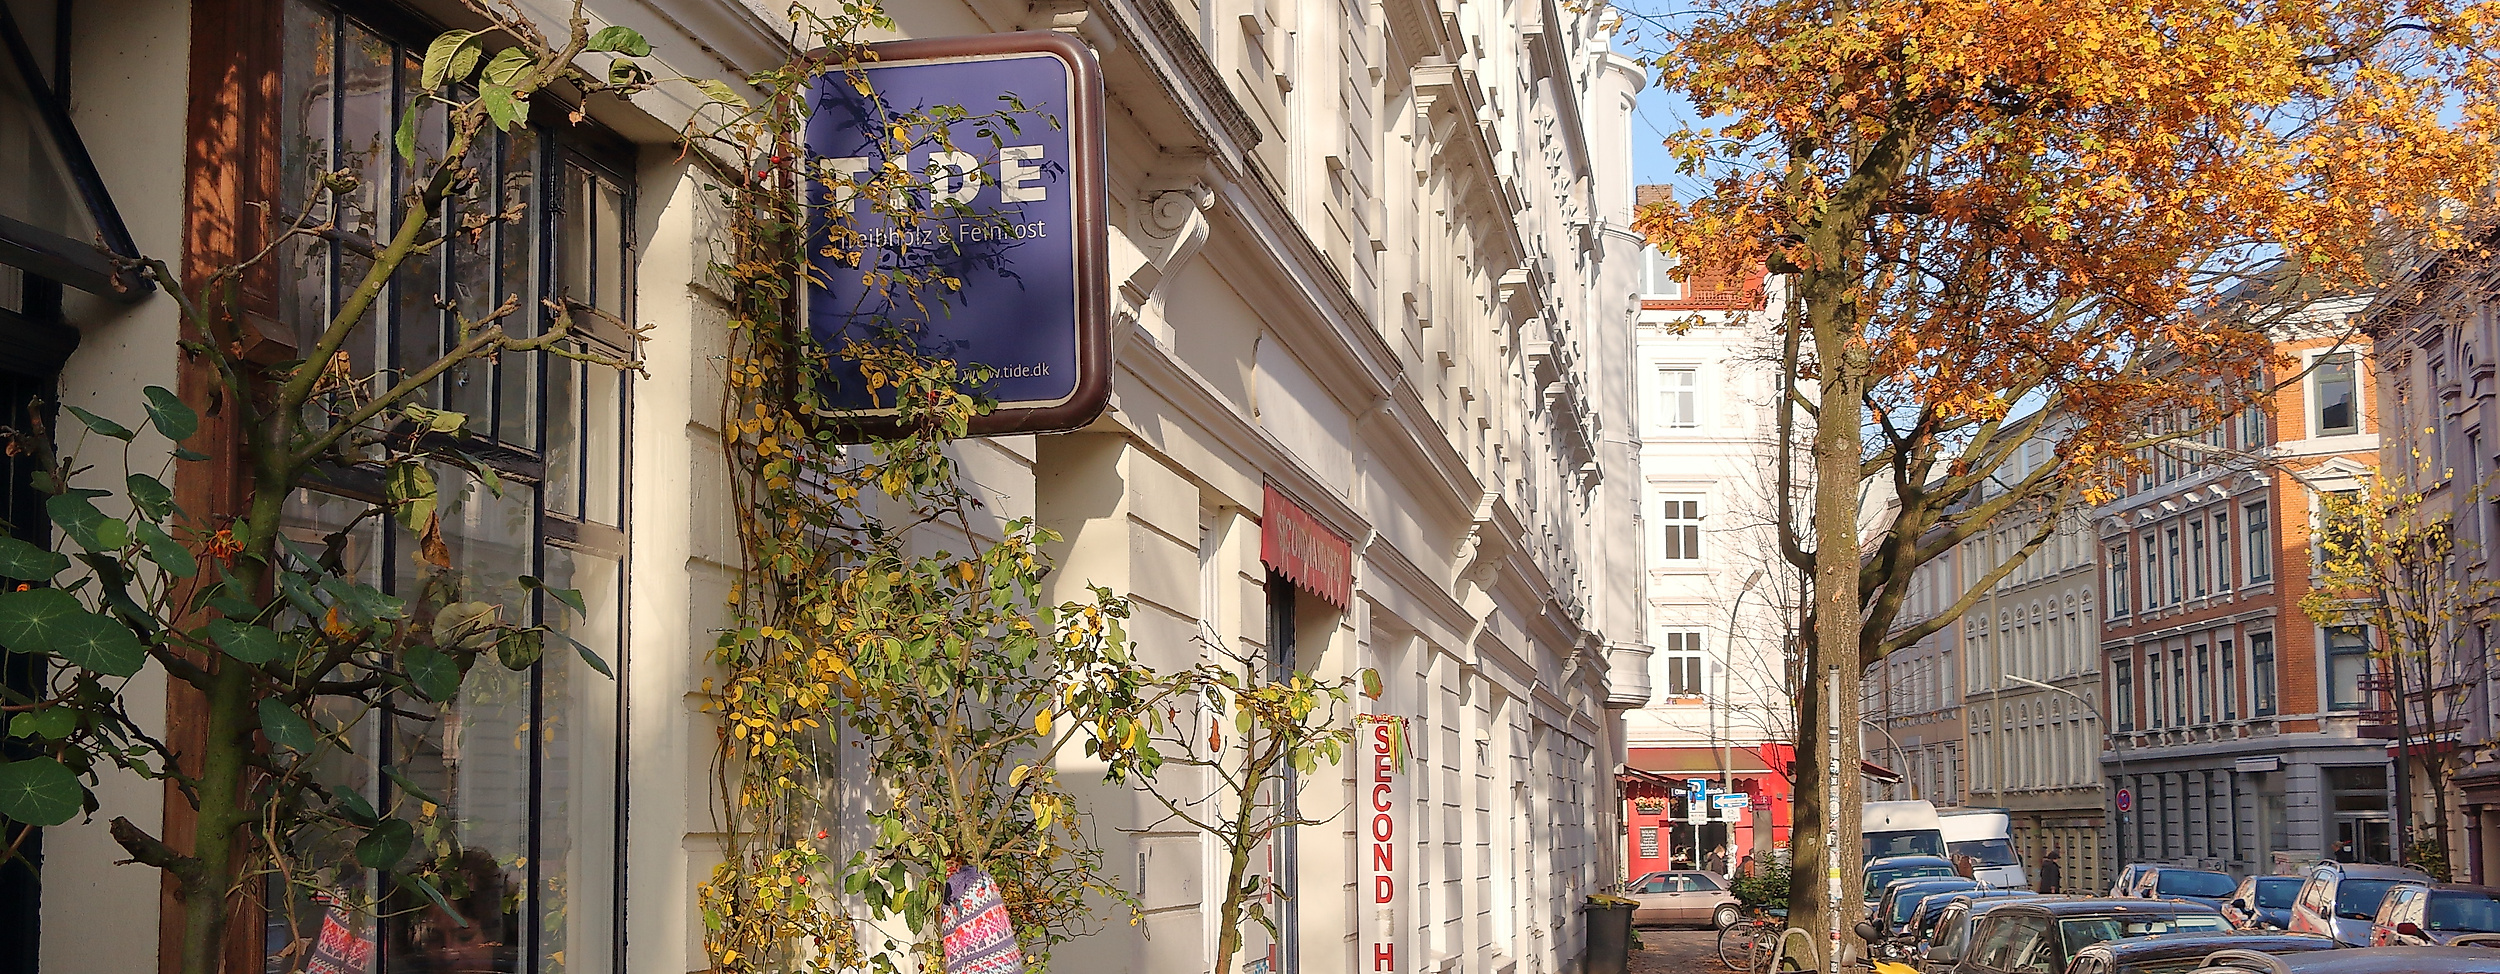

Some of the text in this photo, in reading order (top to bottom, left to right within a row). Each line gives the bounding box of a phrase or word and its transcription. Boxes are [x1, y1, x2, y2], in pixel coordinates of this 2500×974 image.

[819, 144, 1047, 213] TIDE
[938, 224, 952, 244] &
[1372, 725, 1394, 904] SECOND
